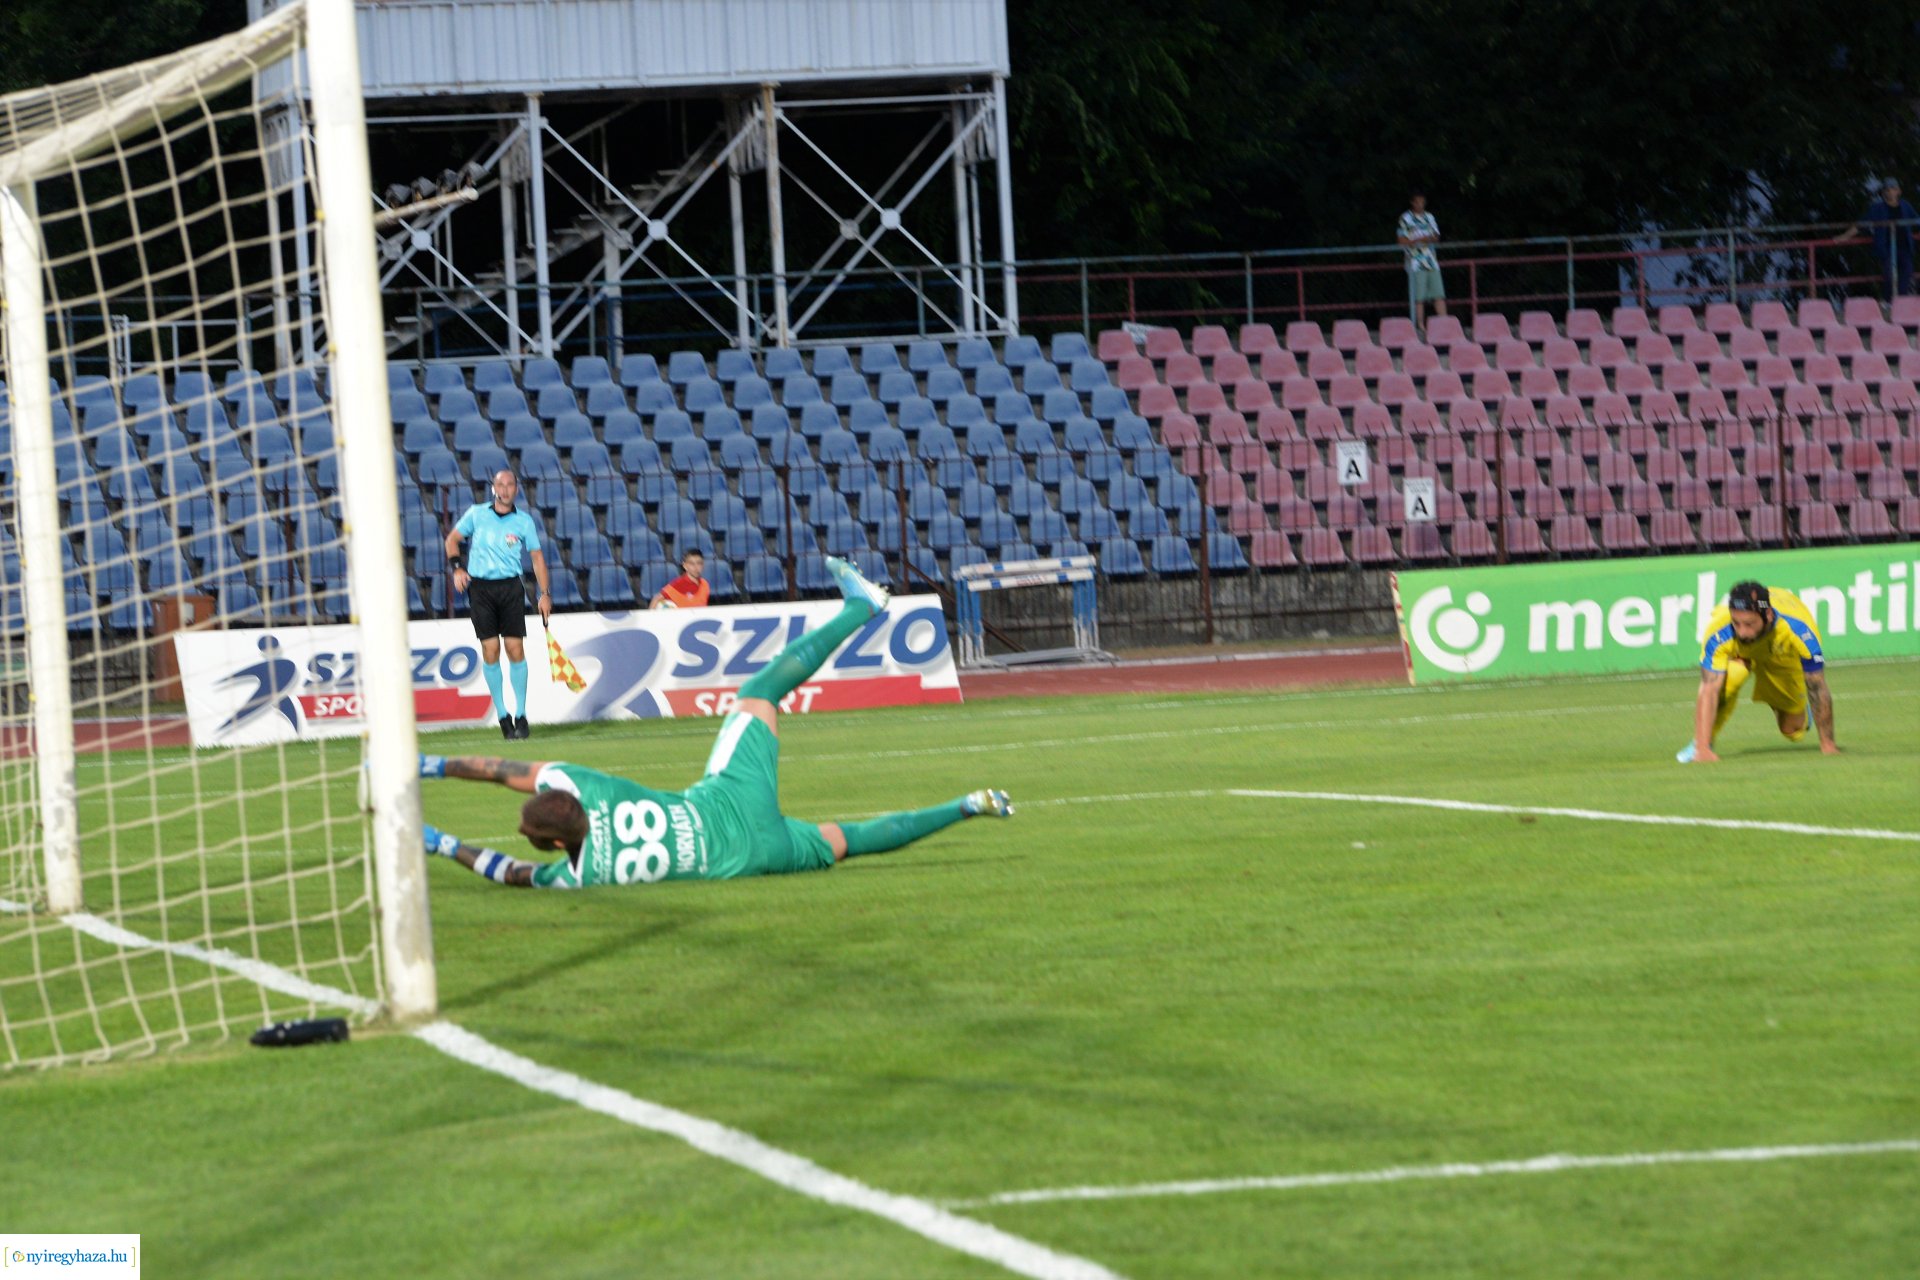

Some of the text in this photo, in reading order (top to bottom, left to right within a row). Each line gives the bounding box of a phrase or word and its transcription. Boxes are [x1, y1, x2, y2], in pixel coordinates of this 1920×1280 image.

[1345, 459, 1361, 479] A
[1412, 496, 1428, 516] A
[613, 798, 670, 884] 88
[667, 804, 695, 873] HORVÁTH
